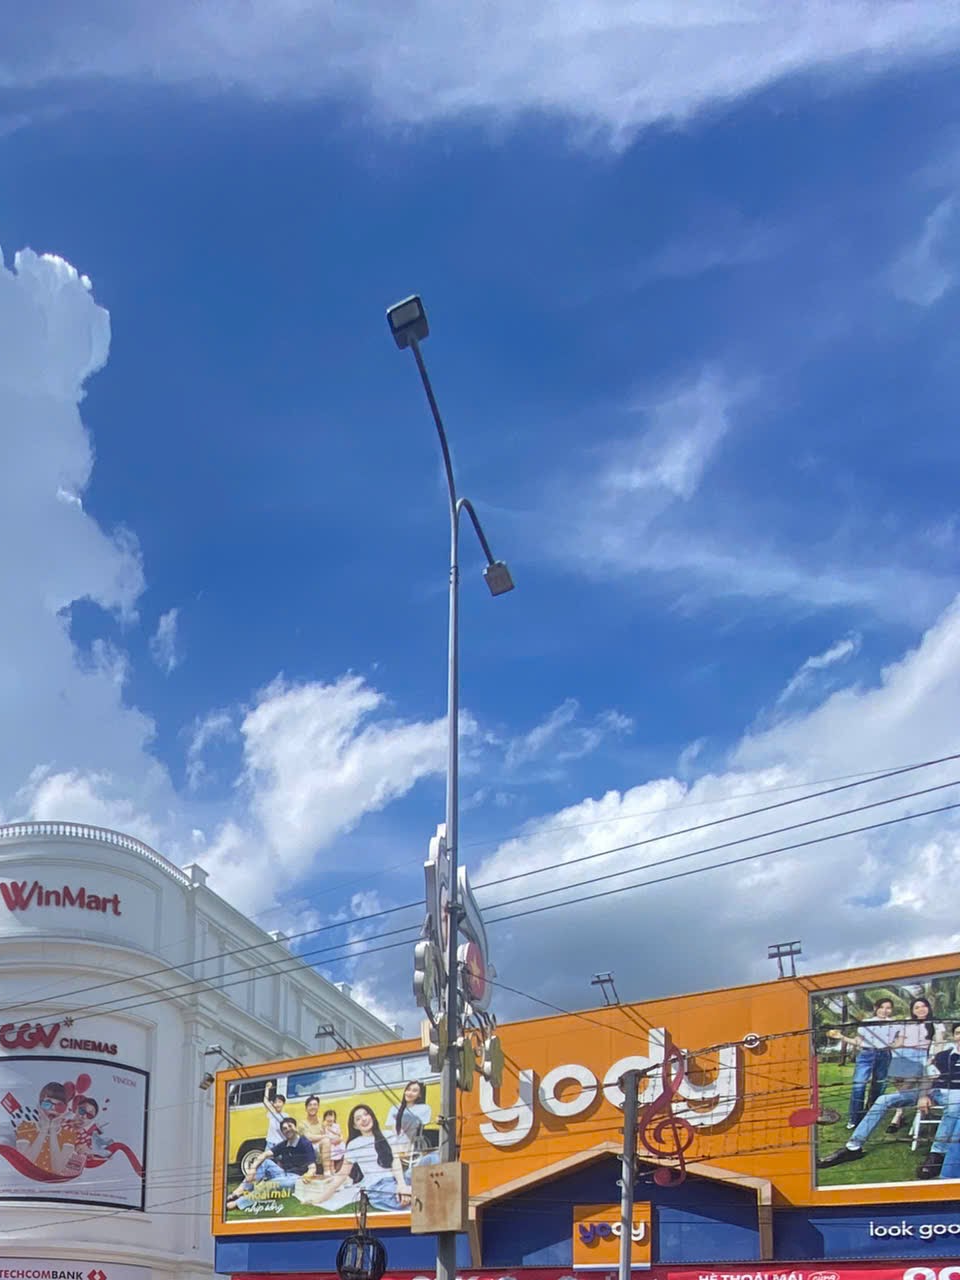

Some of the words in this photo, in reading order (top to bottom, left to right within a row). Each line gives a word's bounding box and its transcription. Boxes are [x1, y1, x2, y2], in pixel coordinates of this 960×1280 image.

[0, 881, 121, 916] WinMart
[60, 1038, 118, 1055] CINEMAS
[479, 1027, 737, 1147] yody
[869, 1220, 914, 1237] look
